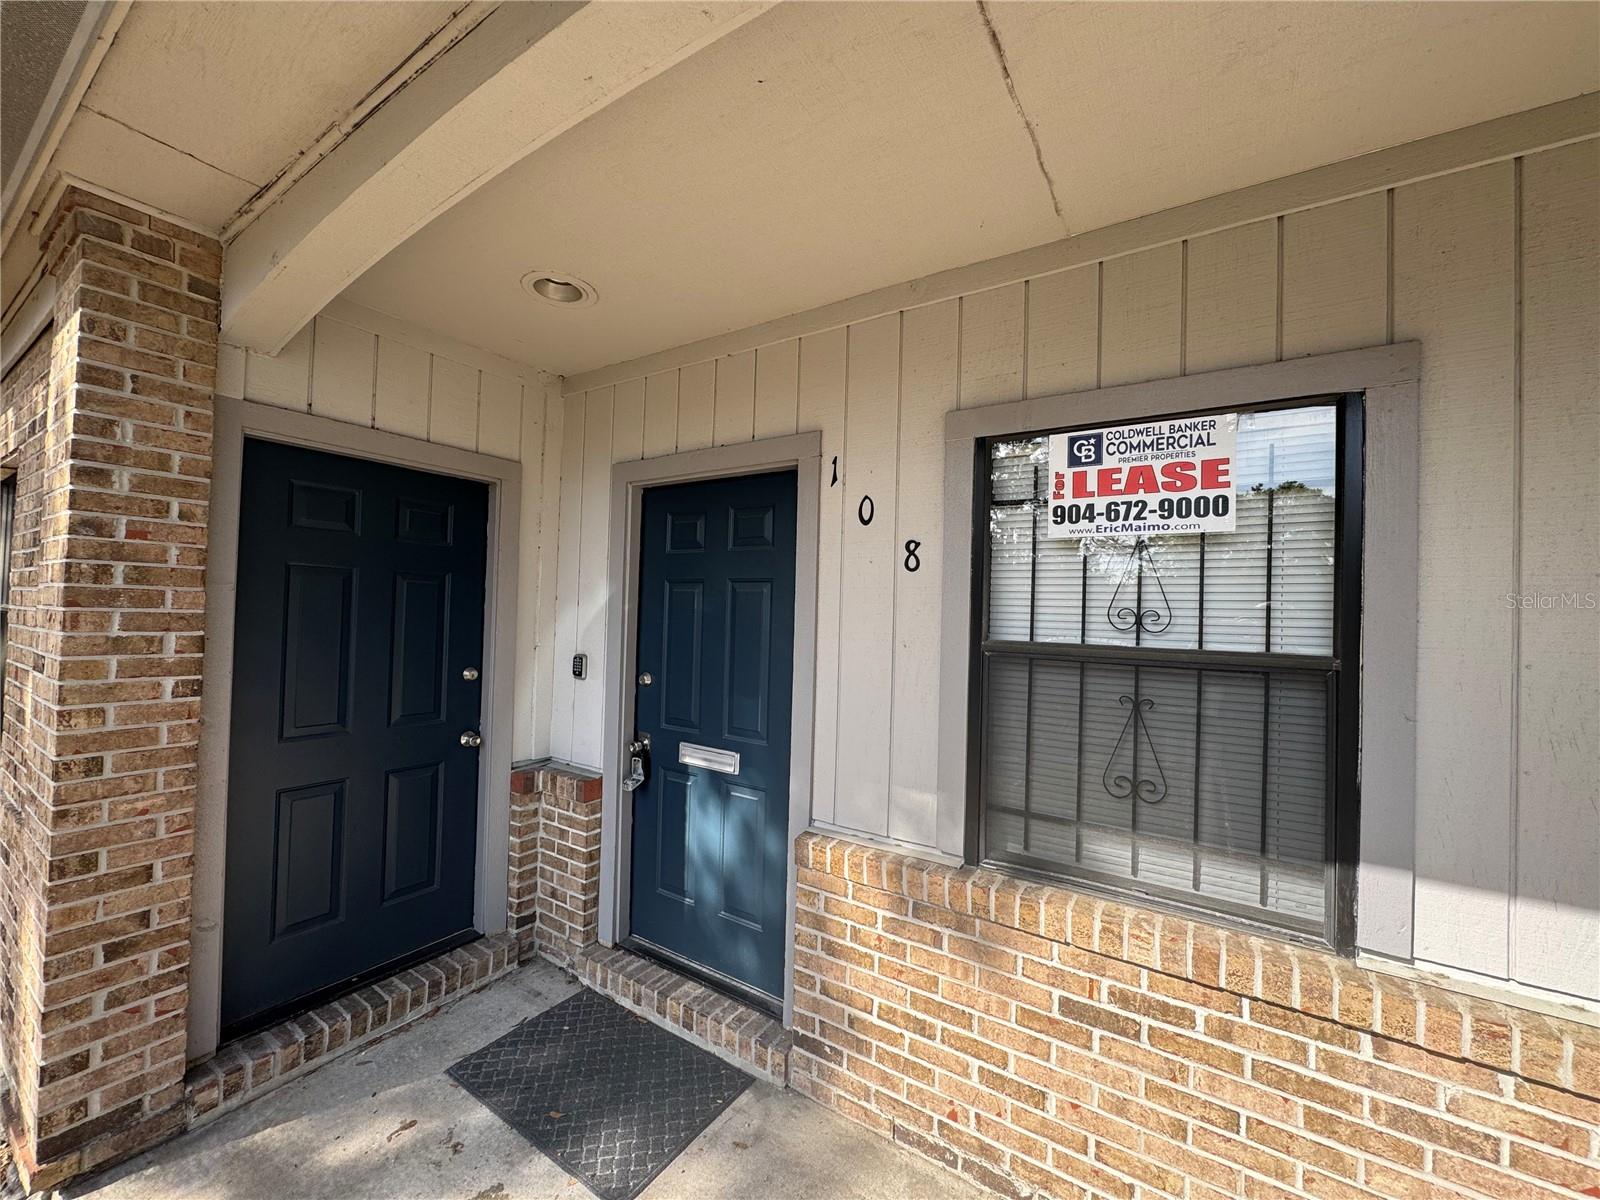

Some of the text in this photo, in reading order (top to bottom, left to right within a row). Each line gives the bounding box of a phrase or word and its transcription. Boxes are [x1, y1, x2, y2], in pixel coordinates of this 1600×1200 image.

[1106, 419, 1217, 441] COLDWELL BANKER
[1106, 432, 1216, 456] COMMERCIAL
[1118, 450, 1196, 464] PREMIER PROPERTIES
[1072, 457, 1231, 499] LEASE
[1052, 494, 1230, 525] 904-672-9000
[1068, 522, 1201, 535] www.EricMaimo.com
